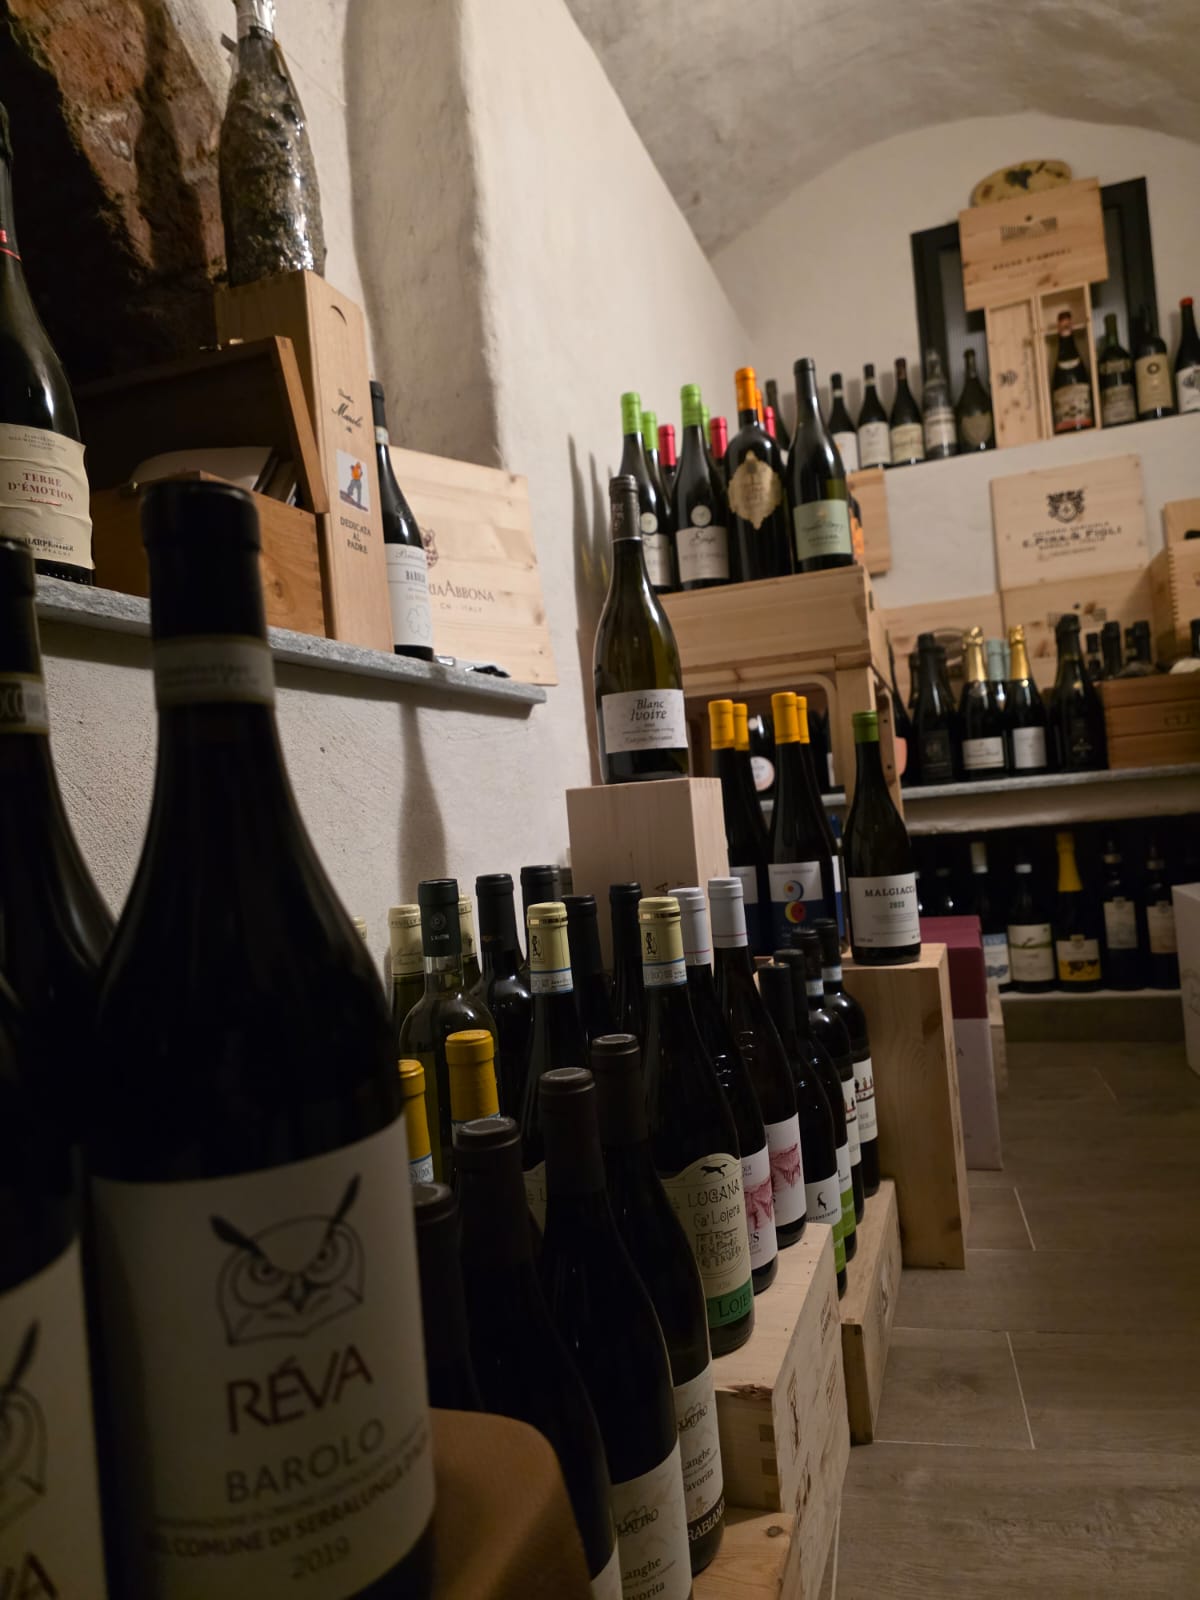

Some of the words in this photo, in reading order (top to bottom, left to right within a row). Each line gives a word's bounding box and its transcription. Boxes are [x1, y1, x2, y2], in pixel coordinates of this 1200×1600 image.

[22, 472, 62, 487] TERRE
[8, 481, 74, 502] D'ÉMOTION
[339, 516, 371, 537] DEDICATA
[352, 532, 361, 542] AL
[346, 538, 368, 554] PADRE
[630, 708, 668, 721] Ivoire
[637, 698, 665, 710] Blanc
[687, 1178, 740, 1209] LUGANA
[711, 1204, 740, 1225] Lojera
[226, 1343, 374, 1436] RÉVA
[225, 1418, 386, 1504] BAROLO
[683, 1446, 711, 1471] anghe
[290, 1534, 351, 1580] 2019
[624, 1556, 663, 1581] anghe
